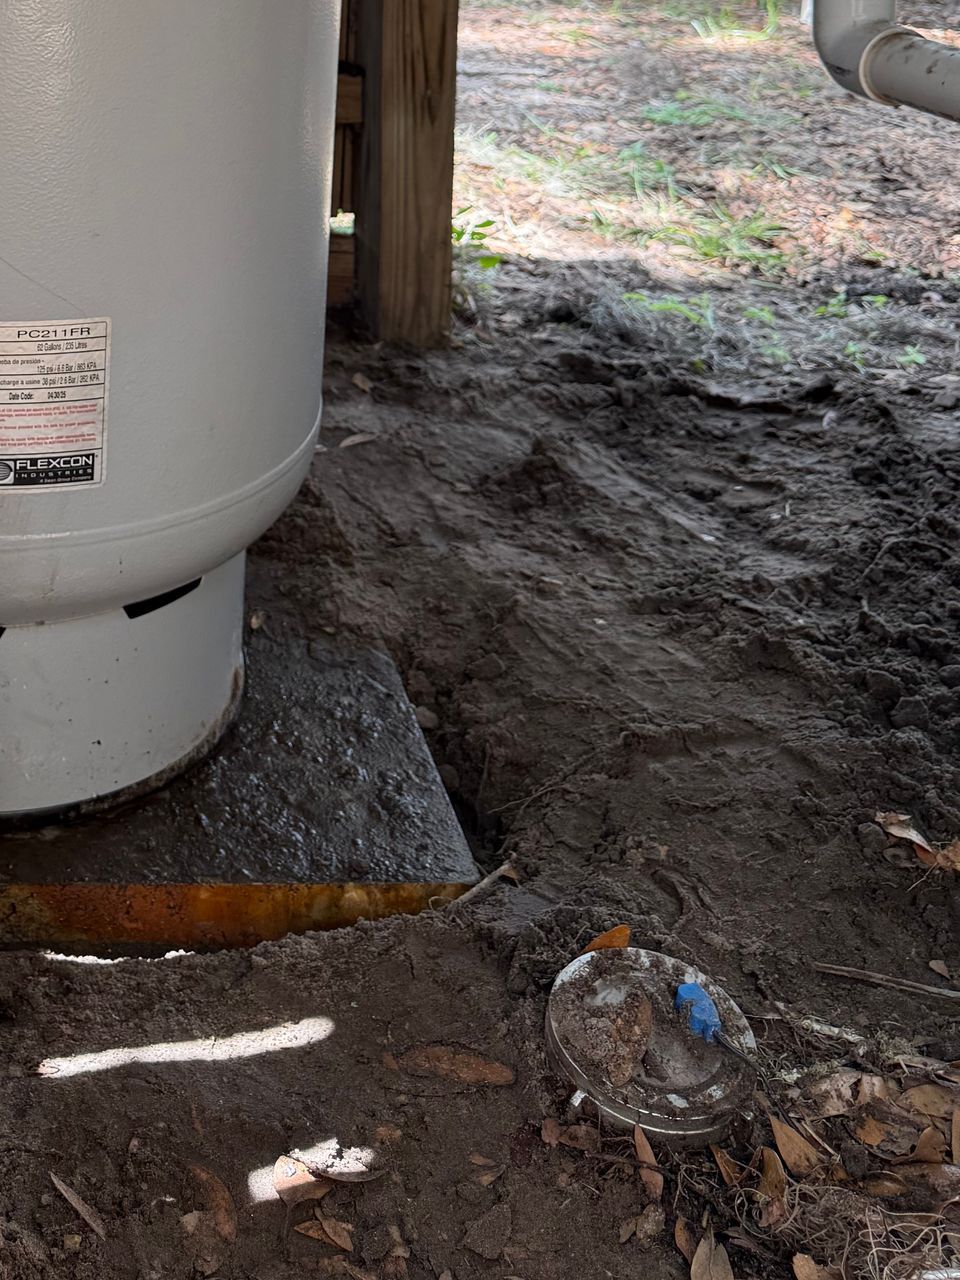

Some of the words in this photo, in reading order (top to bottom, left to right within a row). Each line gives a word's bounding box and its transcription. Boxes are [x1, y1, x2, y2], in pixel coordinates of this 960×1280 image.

[17, 327, 91, 339] PC211FR
[44, 342, 62, 351] Gallons
[8, 391, 20, 400] Date
[16, 455, 93, 470] FLEXCON
[15, 468, 92, 478] INDUSTRIES
